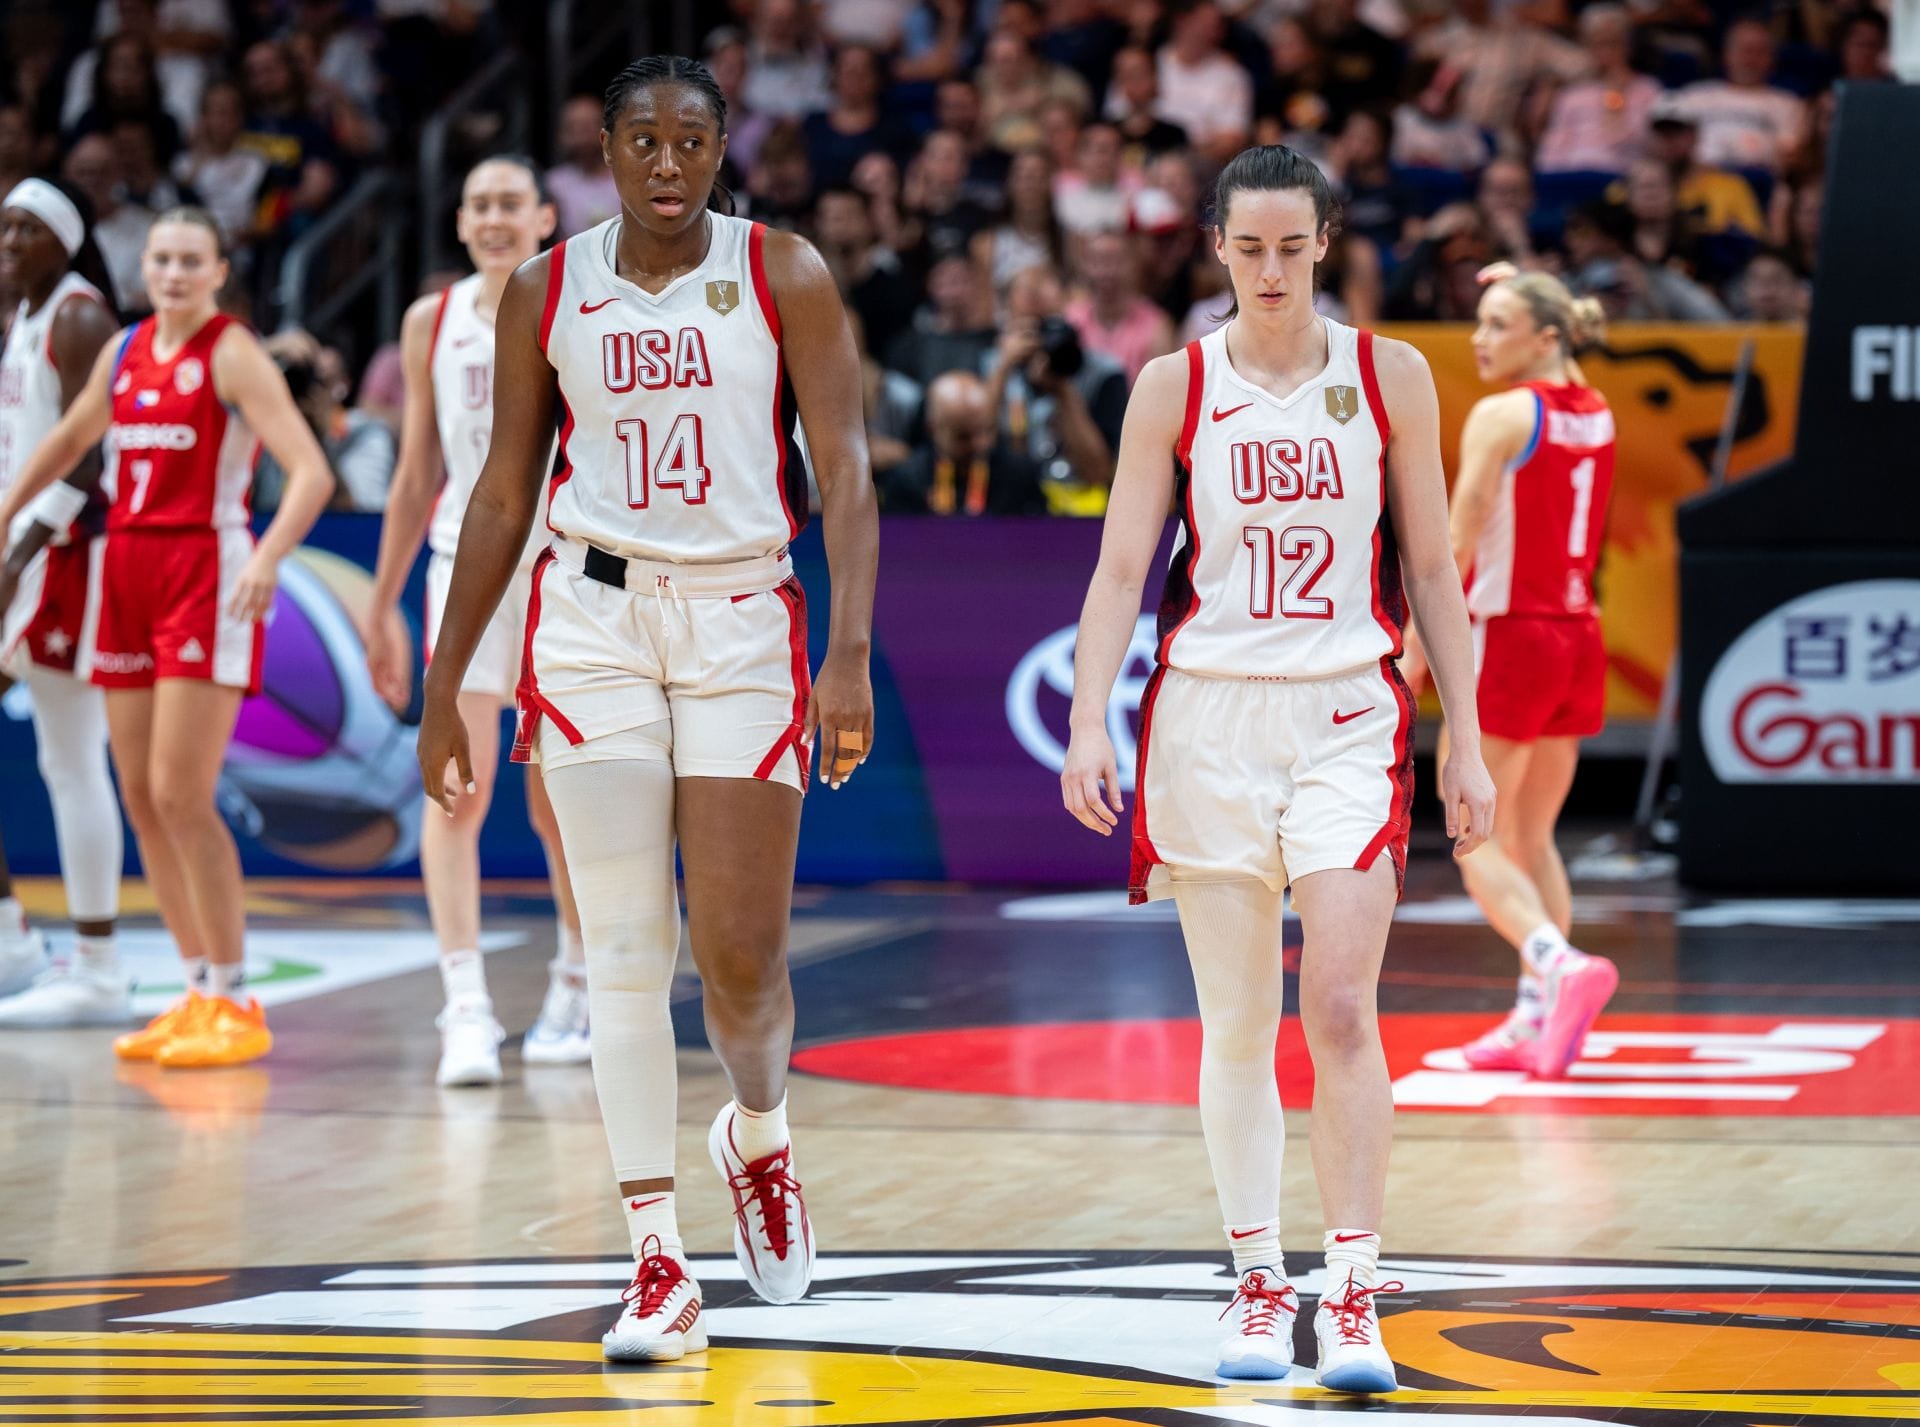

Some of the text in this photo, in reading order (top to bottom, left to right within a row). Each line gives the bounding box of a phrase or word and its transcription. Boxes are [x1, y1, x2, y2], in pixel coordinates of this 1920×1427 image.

[602, 327, 713, 393] USA
[1850, 324, 1920, 401] FI
[130, 459, 153, 515] 7
[616, 413, 711, 509] 14
[1231, 438, 1344, 504] USA
[1568, 456, 1596, 557] 1
[1243, 526, 1334, 620] 12
